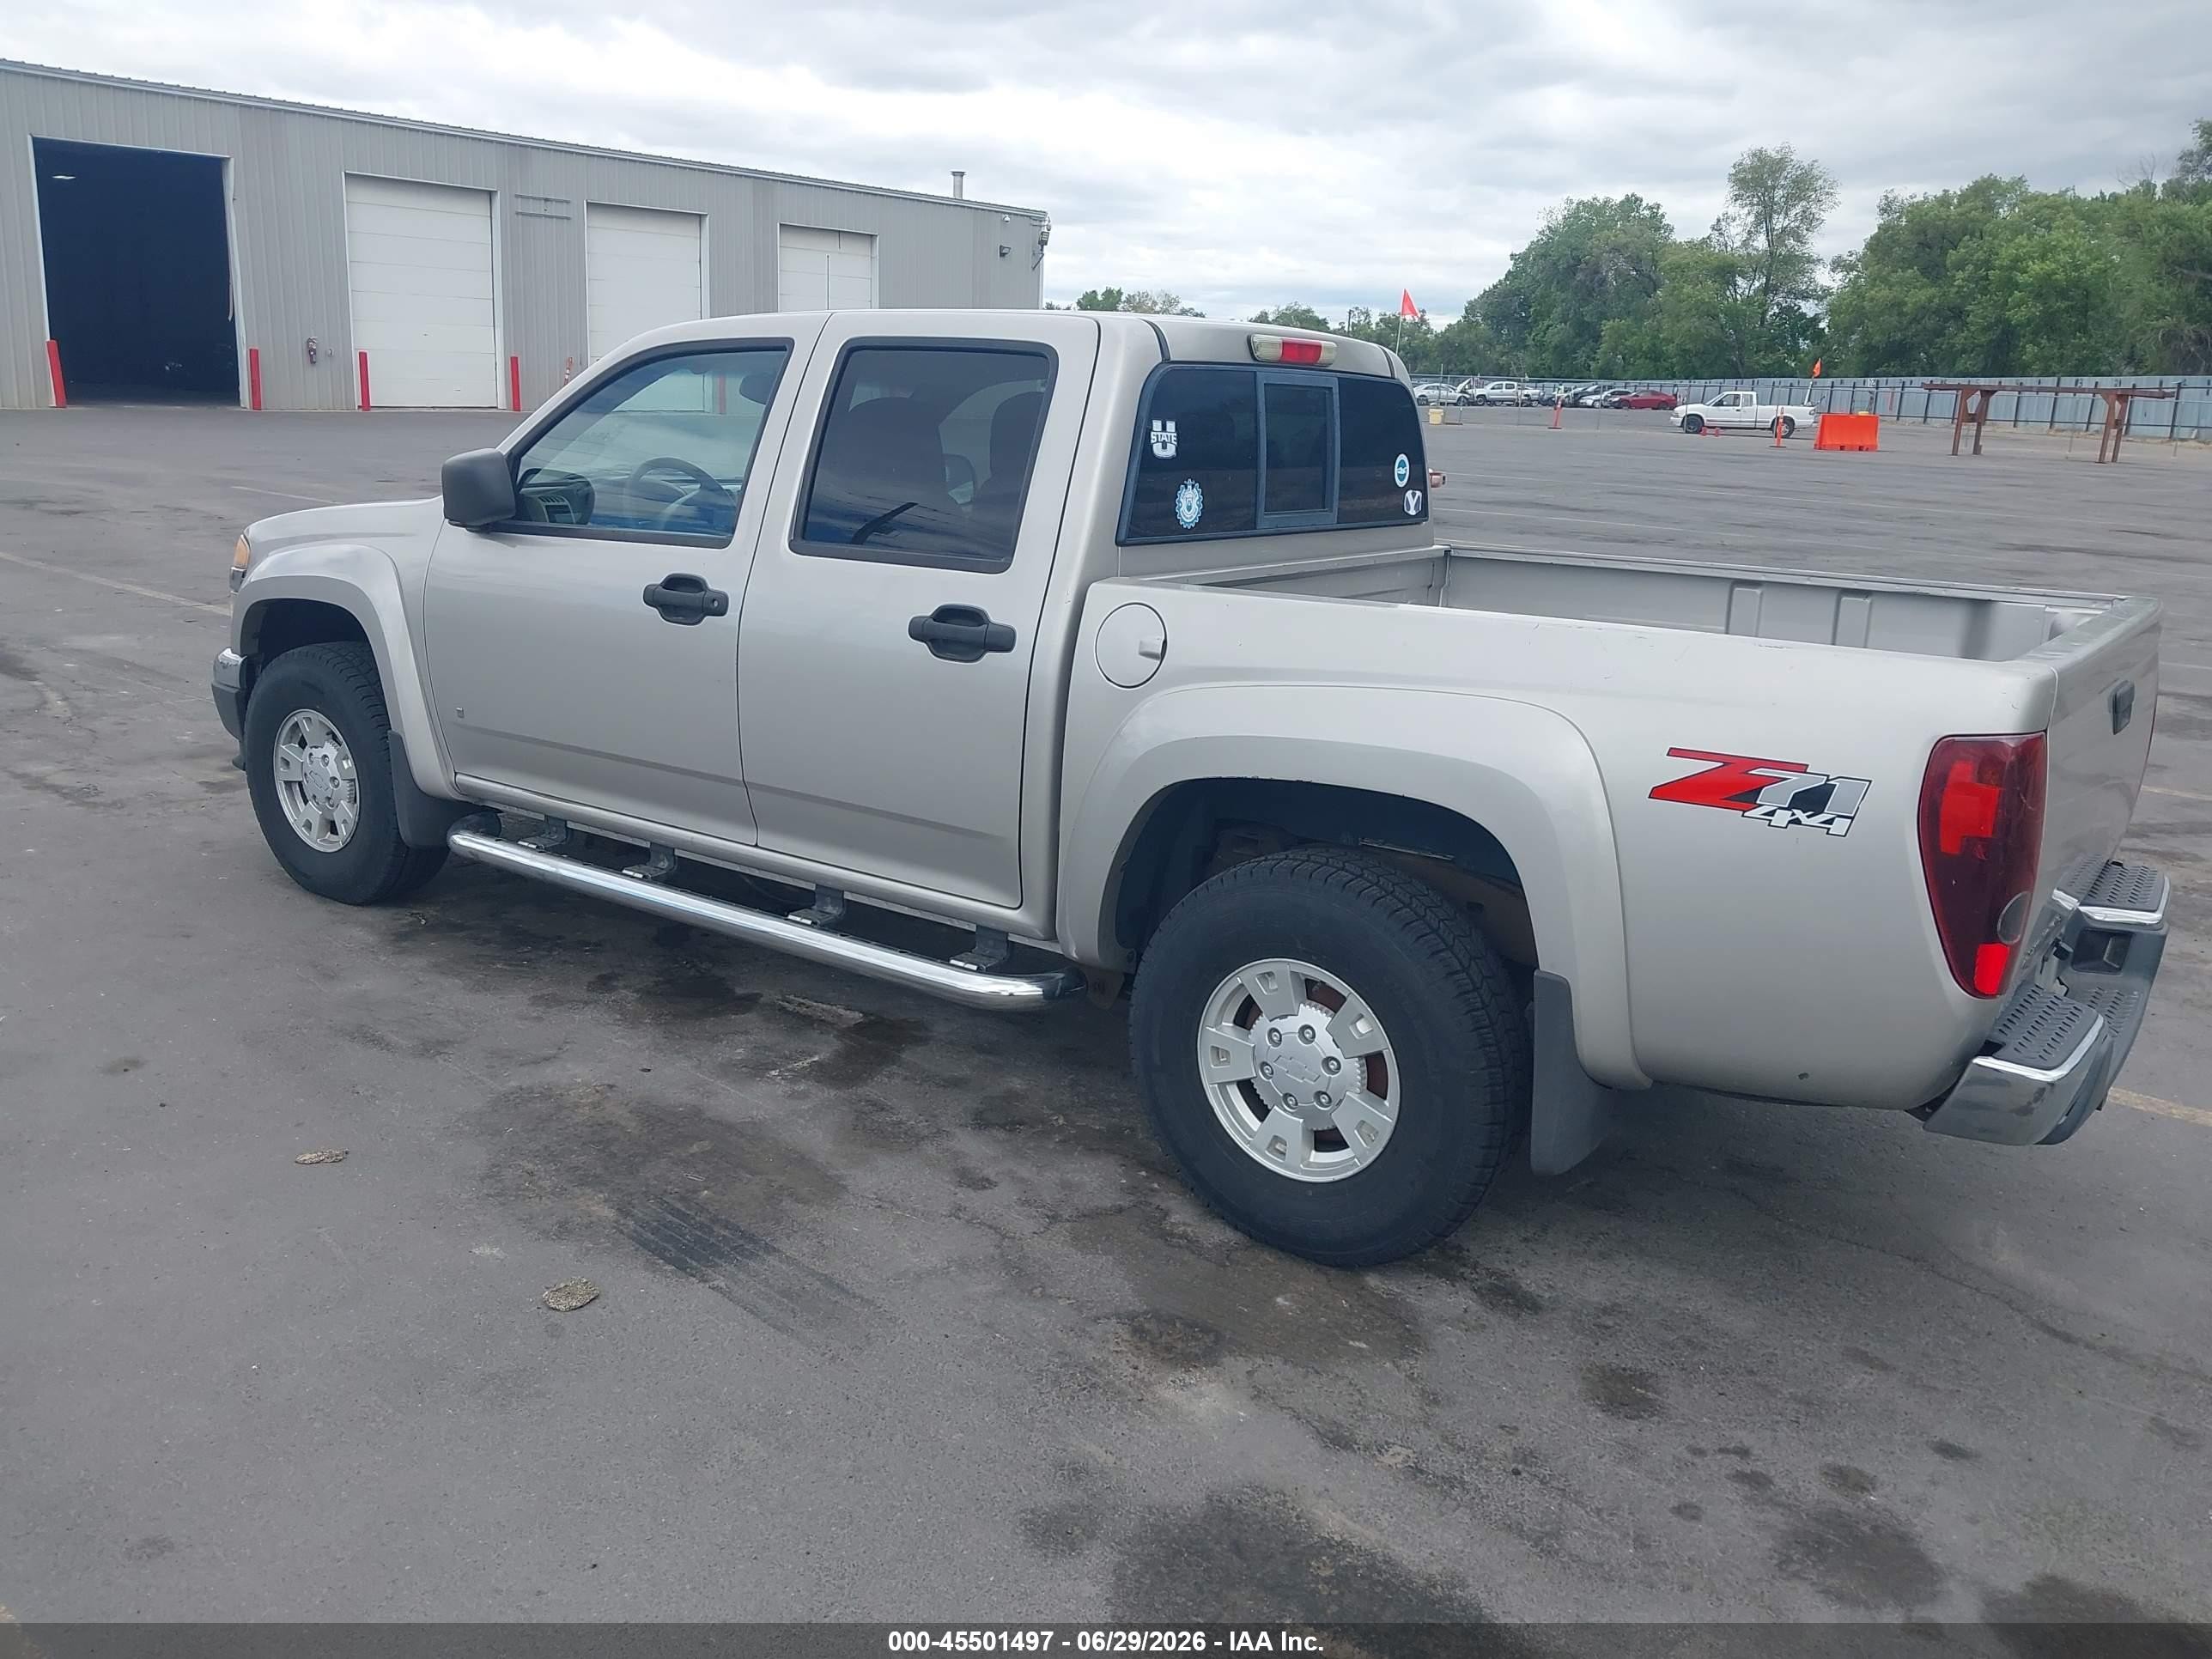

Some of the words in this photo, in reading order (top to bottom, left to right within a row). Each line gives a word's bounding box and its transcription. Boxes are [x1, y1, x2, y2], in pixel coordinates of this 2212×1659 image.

[1151, 431, 1177, 446] STATE
[1152, 419, 1176, 459] U
[1648, 747, 1873, 817] Z71
